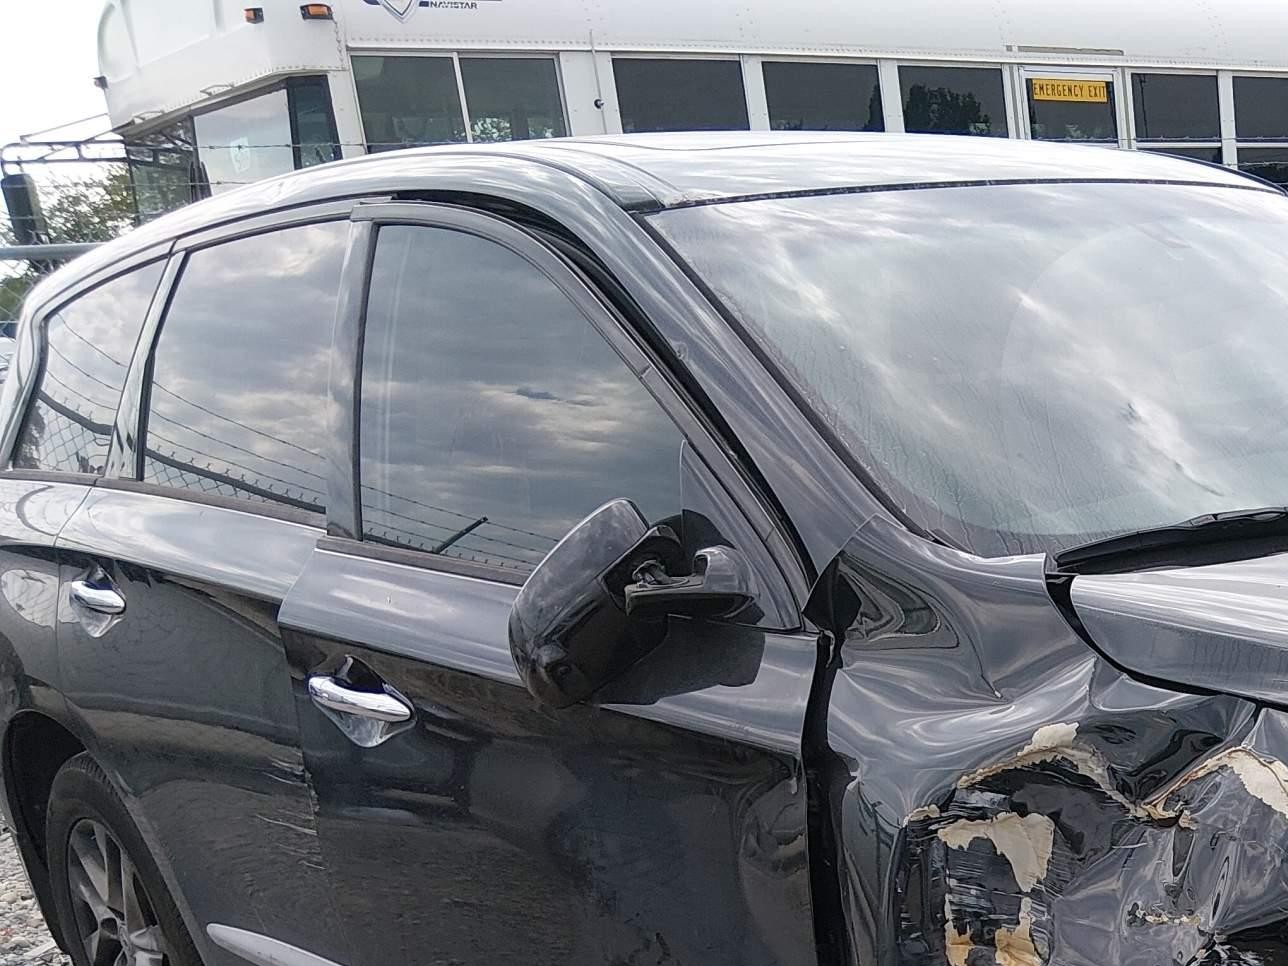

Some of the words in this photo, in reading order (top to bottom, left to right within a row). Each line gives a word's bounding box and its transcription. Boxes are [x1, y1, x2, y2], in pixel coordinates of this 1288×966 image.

[430, 0, 478, 9] NAVISTAR
[1033, 82, 1083, 97] EMERGENCY
[1088, 85, 1106, 98] EXIT
